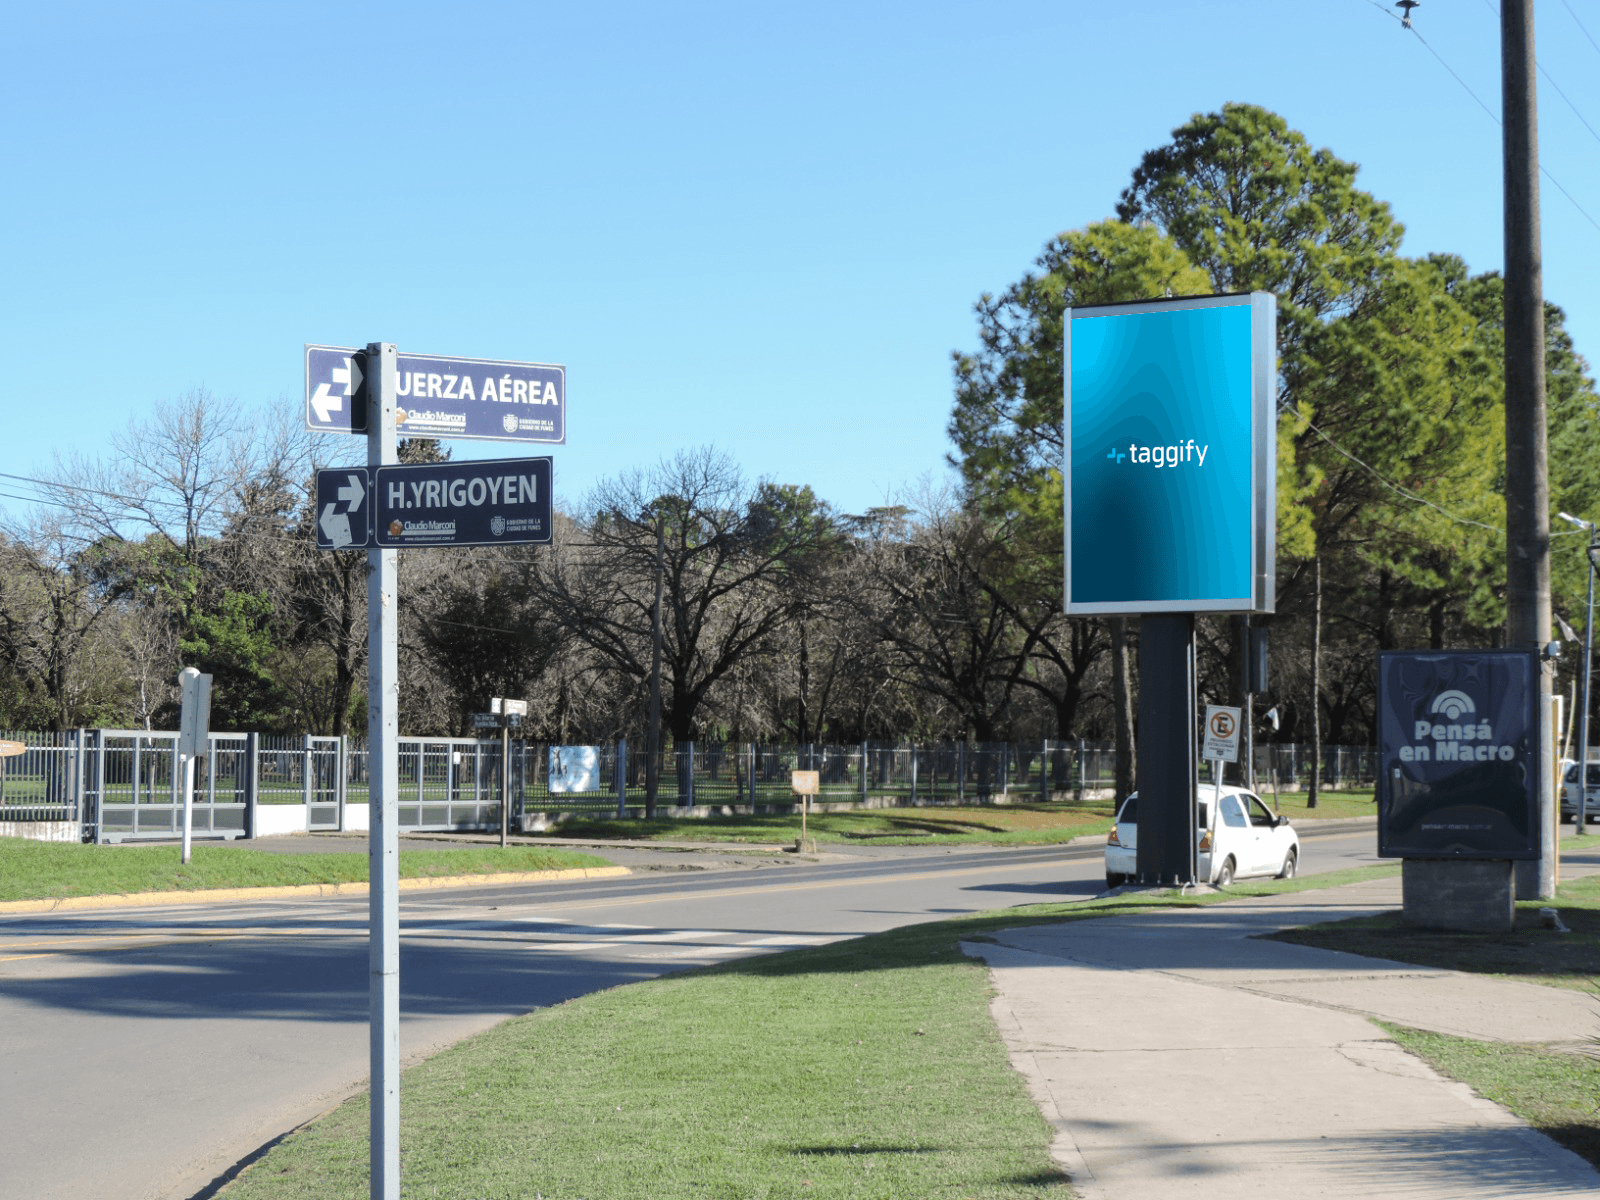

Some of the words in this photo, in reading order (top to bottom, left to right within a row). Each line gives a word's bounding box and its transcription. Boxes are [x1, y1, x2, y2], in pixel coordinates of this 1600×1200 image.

[395, 371, 476, 401] UERZA
[481, 374, 558, 406] AÉREA
[408, 409, 435, 420] Claudio
[435, 410, 467, 422] Marconi
[1129, 439, 1208, 468] taggify
[388, 474, 537, 509] H.YRIGOYEN
[404, 520, 428, 531] Claudio
[428, 519, 456, 530] Marconi
[1415, 718, 1493, 740] Pensá
[1399, 745, 1430, 761] en
[1435, 741, 1515, 761] Macro
